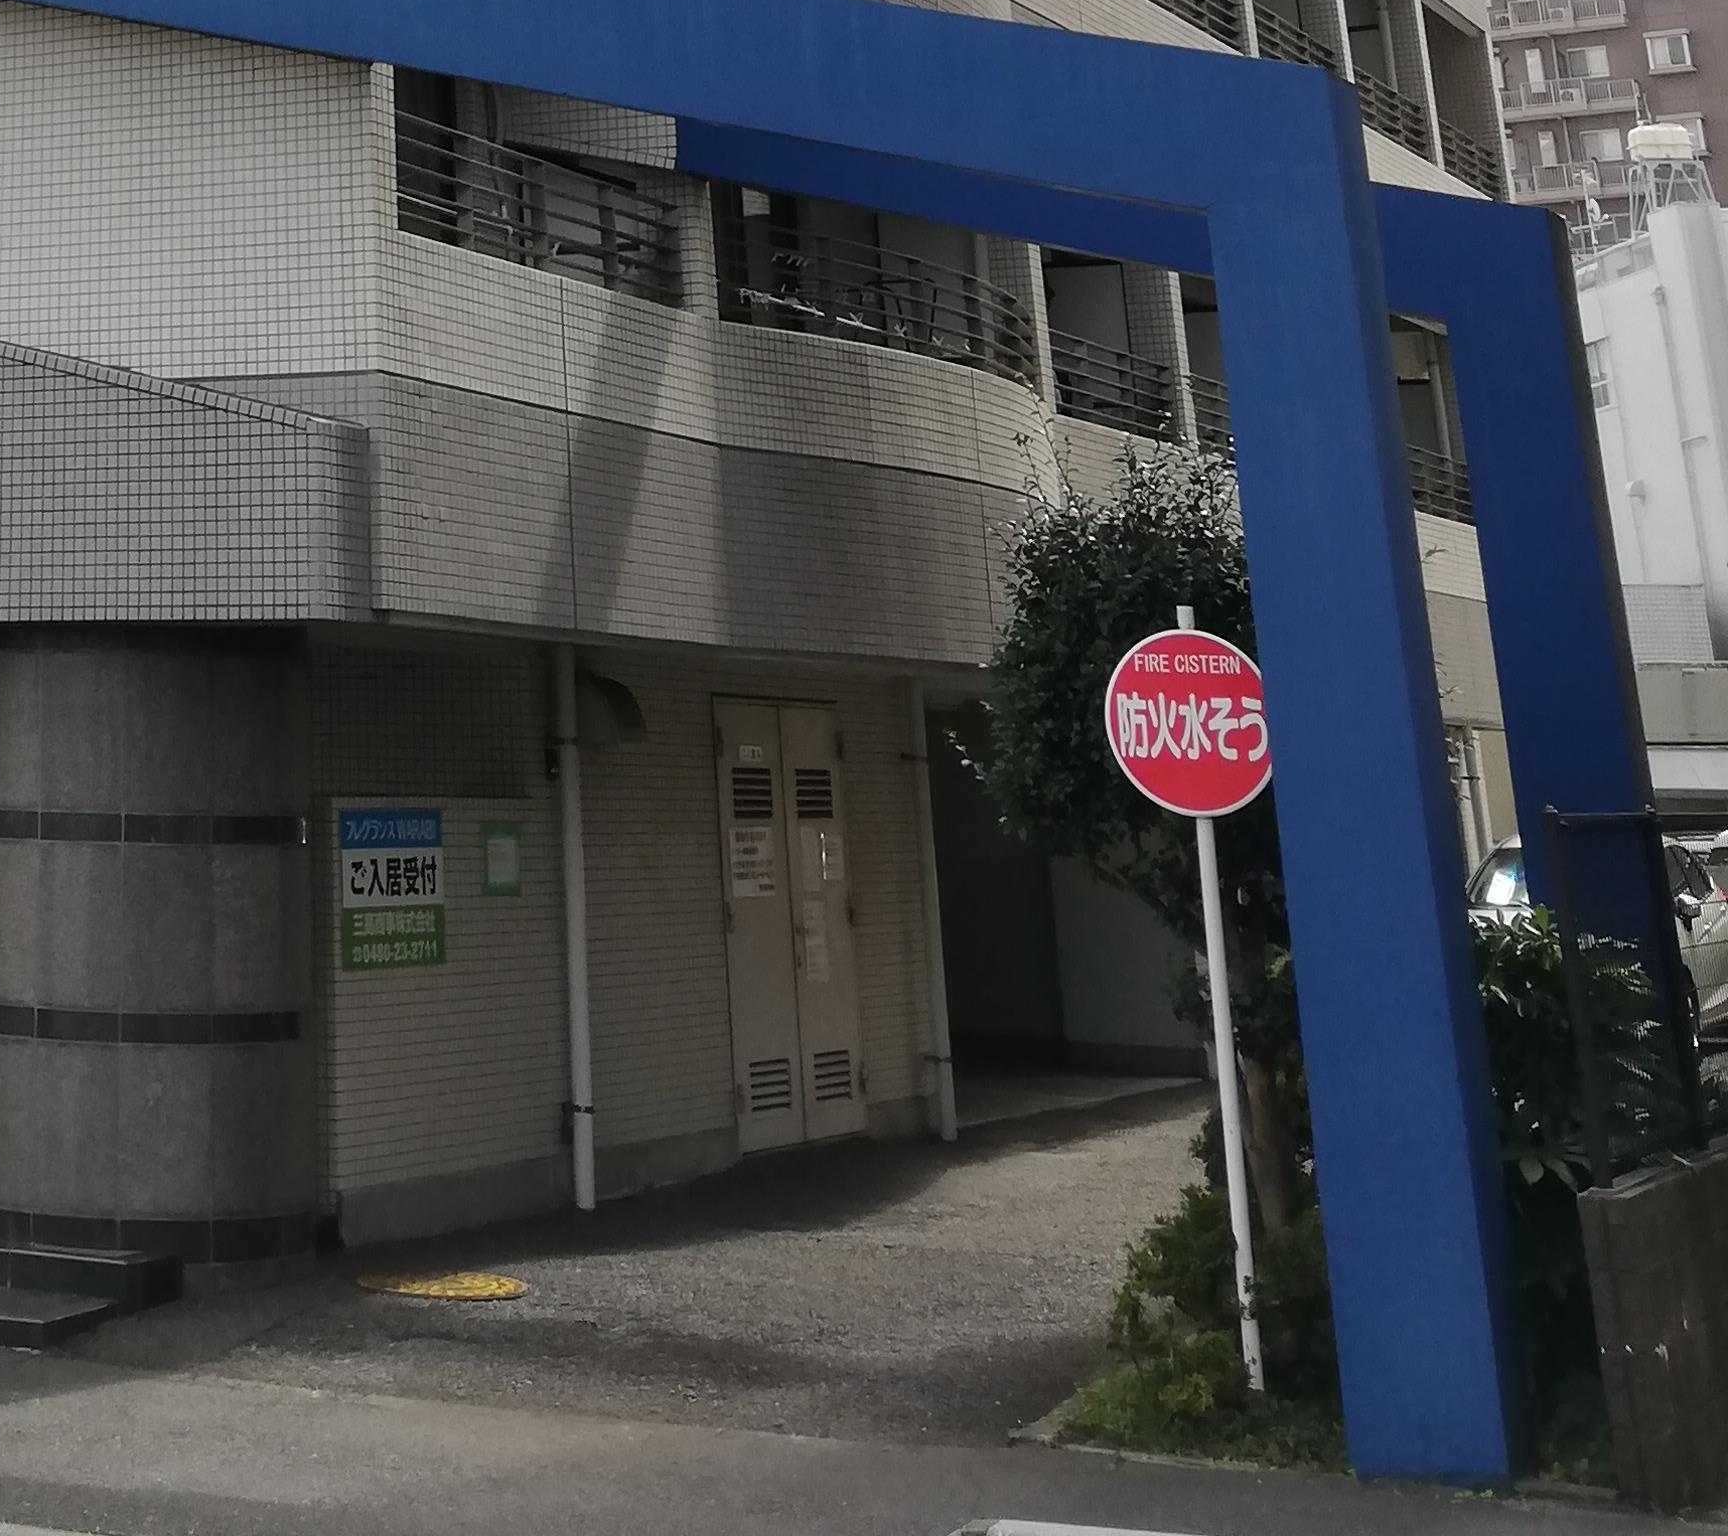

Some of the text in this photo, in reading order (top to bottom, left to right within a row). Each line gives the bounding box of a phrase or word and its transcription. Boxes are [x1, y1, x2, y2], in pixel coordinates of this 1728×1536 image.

[1134, 653, 1241, 674] FIRE CISTERN
[1116, 692, 1268, 762] 防火水そう
[350, 856, 437, 897] ご入居受付
